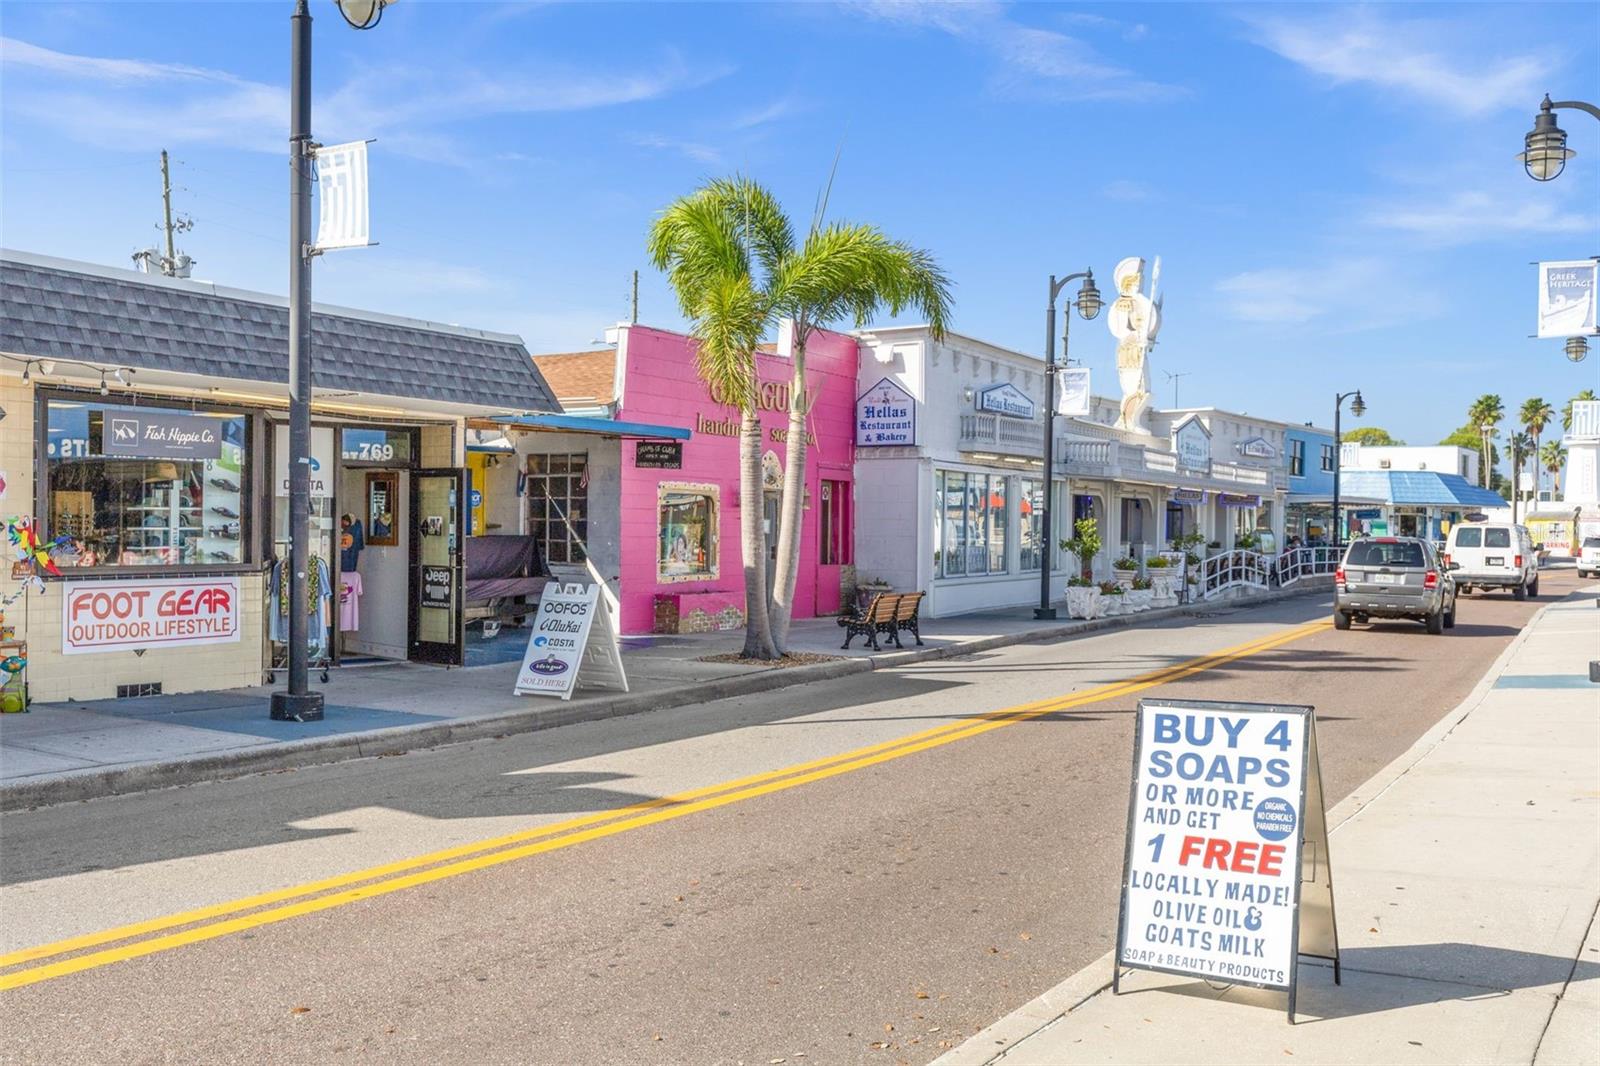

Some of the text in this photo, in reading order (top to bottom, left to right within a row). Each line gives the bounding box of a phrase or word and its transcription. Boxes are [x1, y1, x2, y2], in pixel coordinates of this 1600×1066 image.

[1550, 272, 1577, 281] GREEK
[863, 405, 907, 419] Hellas
[859, 420, 912, 430] Restaurant
[144, 425, 214, 444] Fish Hippie Co.
[864, 432, 907, 442] & Bakery
[359, 442, 394, 460] 769
[283, 479, 324, 491] CTA
[425, 568, 450, 585] Jeep
[72, 588, 231, 621] FOOT GEAR
[544, 602, 588, 615] OOFOS
[72, 616, 231, 641] OUTDOOR LIFESTYLE
[547, 618, 583, 634] OluKai
[548, 638, 575, 648] COSTA
[521, 677, 568, 688] SOLD HERE
[1153, 713, 1292, 751] BUY 4
[1148, 750, 1291, 788] SOAPS
[1145, 783, 1254, 811] OR MORE
[1264, 801, 1287, 811] ORGANIC
[1143, 807, 1221, 831] AND GET
[1257, 812, 1293, 822] NO CHEMICALS
[1147, 833, 1287, 877] 1 FREE
[1131, 870, 1290, 907] LOCALLY MADE!
[1153, 899, 1207, 924] OLIVE
[1145, 923, 1265, 958] GOATS MILK
[1124, 947, 1285, 983] SOAP & BEAUTY PRODUCTS
